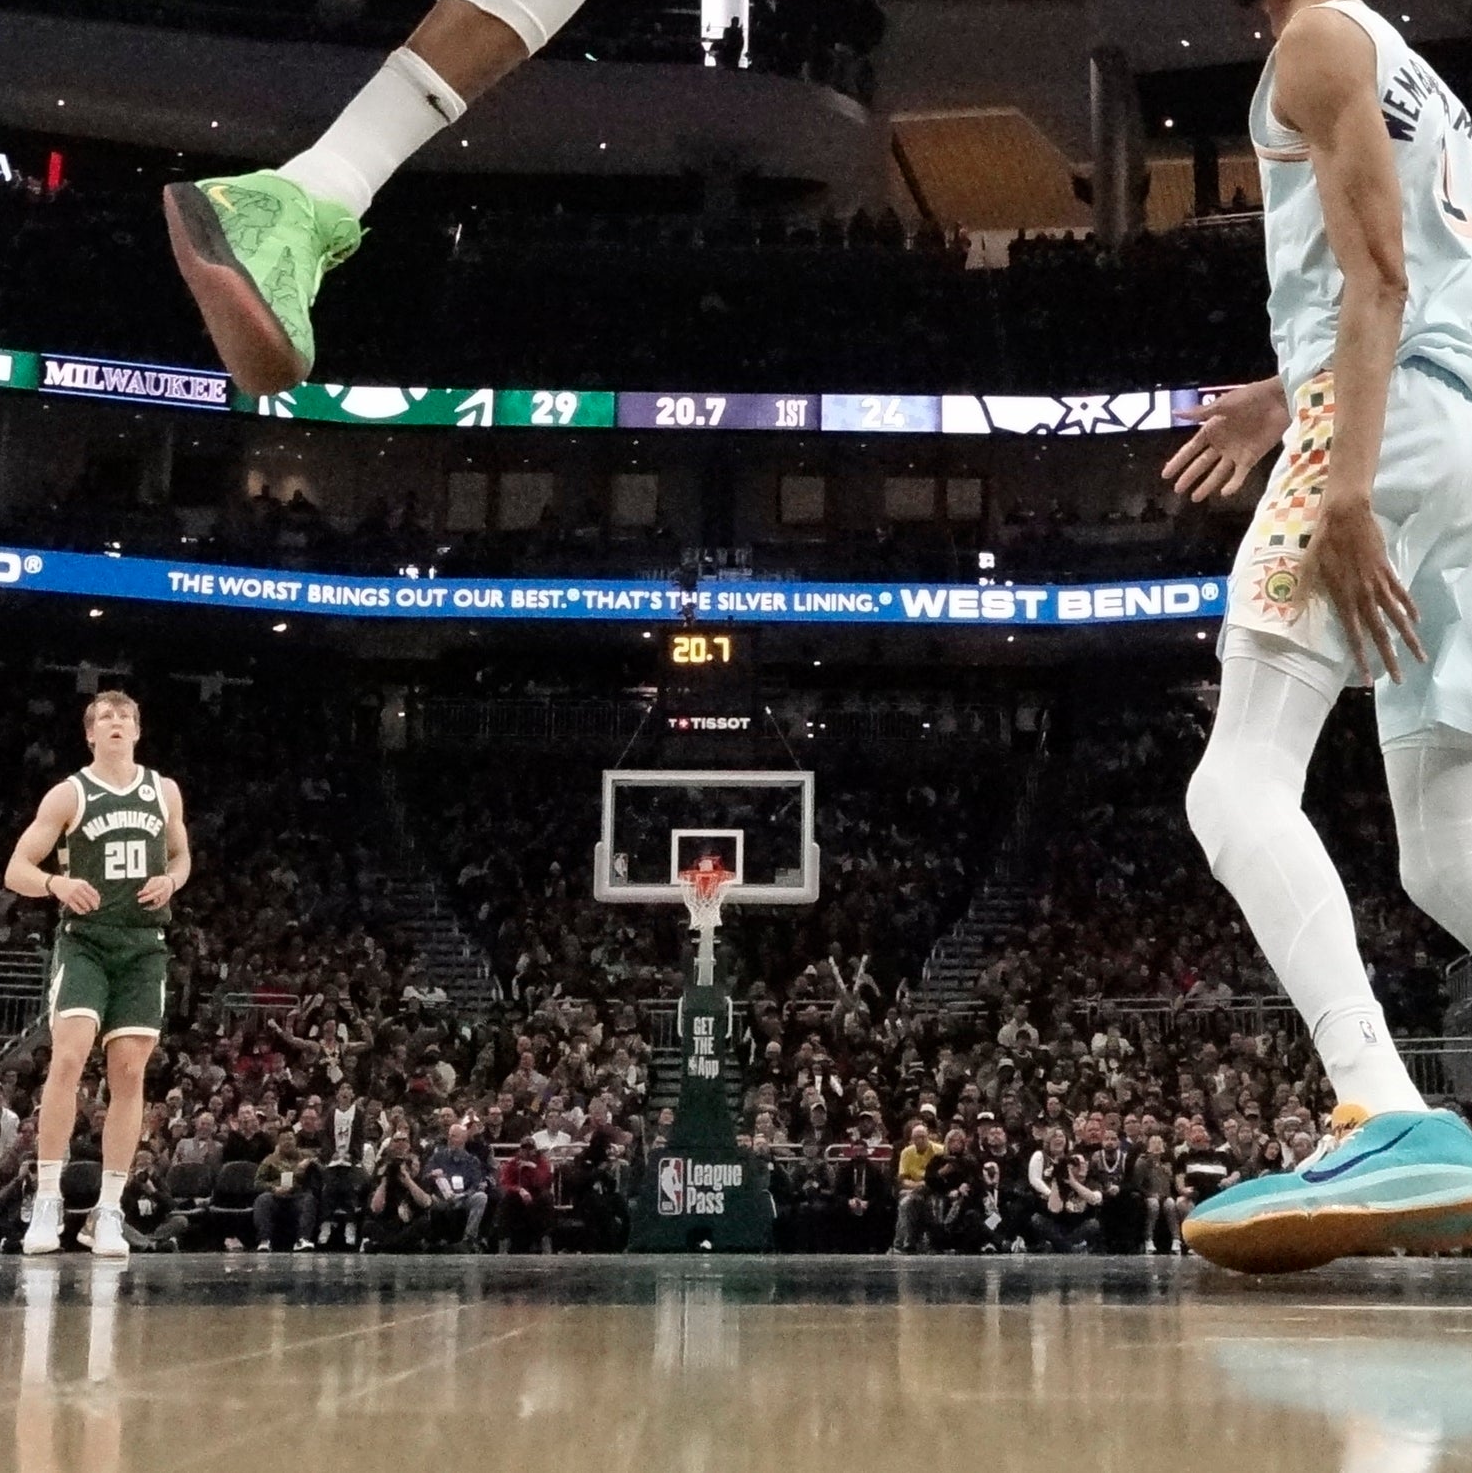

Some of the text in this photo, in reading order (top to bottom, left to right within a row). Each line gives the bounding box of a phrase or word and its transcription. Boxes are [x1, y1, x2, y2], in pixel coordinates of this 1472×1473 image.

[43, 360, 228, 404] MILWAUKEE
[530, 391, 578, 426] 29
[654, 396, 728, 427] 20.7
[774, 399, 809, 428] 1ST
[861, 397, 907, 429] 24
[167, 571, 215, 595] THE
[218, 575, 303, 602] WORST
[307, 583, 391, 608] BRINGS
[395, 587, 448, 608] OUT
[452, 588, 505, 609] OUR
[582, 589, 663, 611] THAT'S
[665, 590, 712, 612] THE
[716, 591, 788, 613] SILVER
[899, 588, 1048, 620] WEST
[672, 636, 730, 663] 20.7
[690, 716, 752, 731] TISSOT
[81, 810, 165, 842] MILWAUKEE
[104, 839, 148, 880] 20
[692, 1016, 715, 1036] GET
[692, 1036, 715, 1055] THE
[697, 1056, 720, 1079] App
[686, 1158, 743, 1191] League
[686, 1186, 725, 1215] Pass
